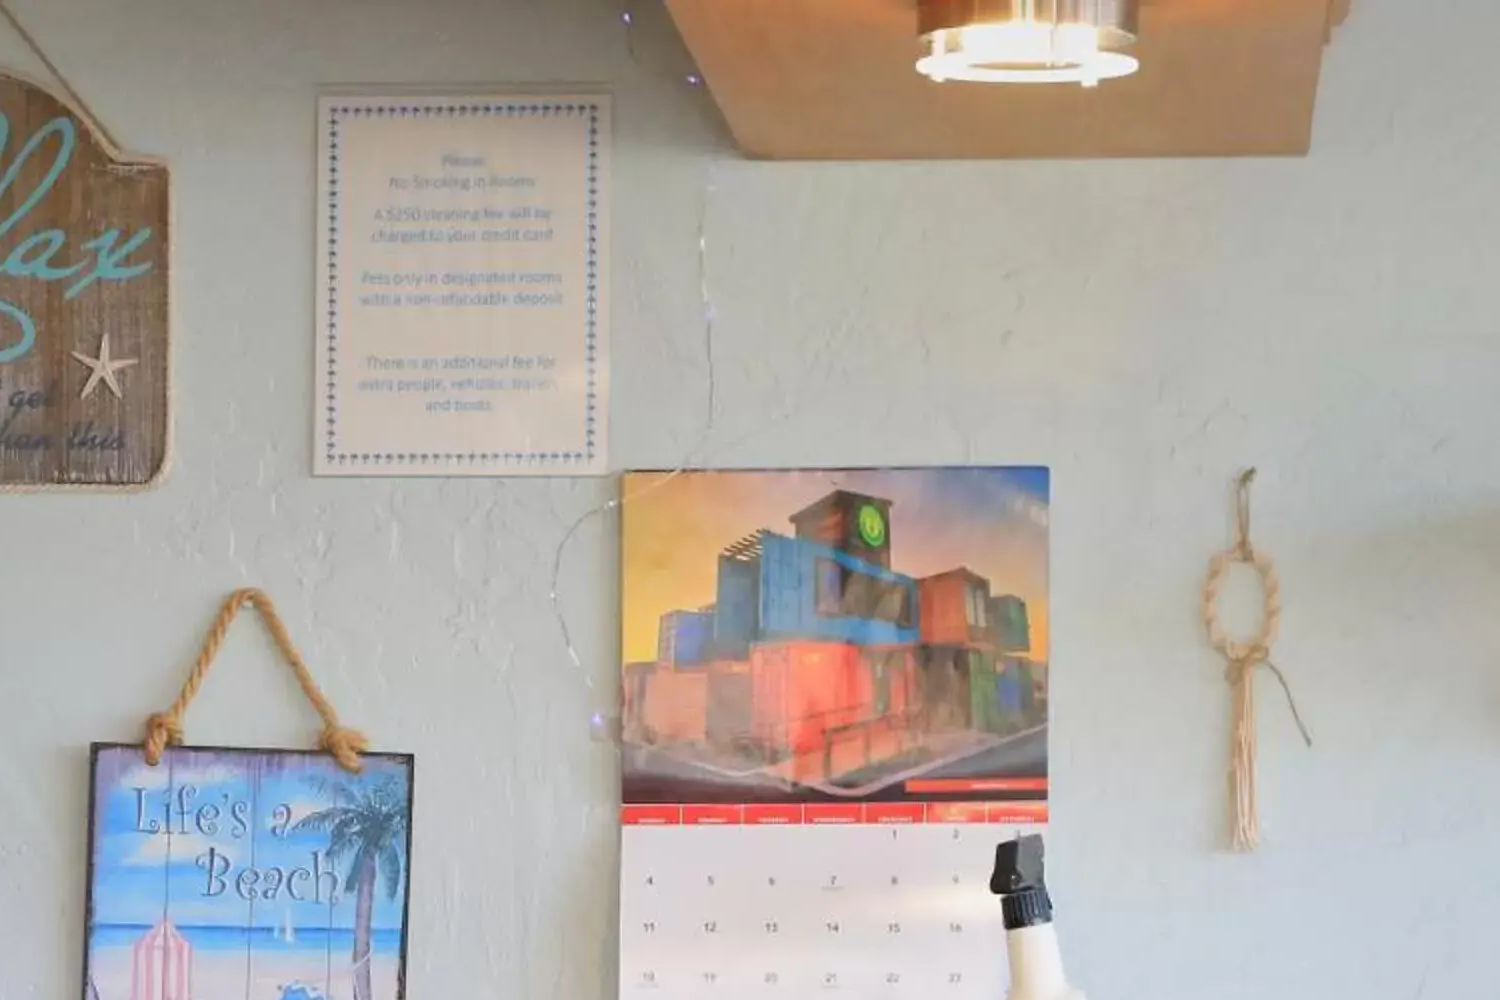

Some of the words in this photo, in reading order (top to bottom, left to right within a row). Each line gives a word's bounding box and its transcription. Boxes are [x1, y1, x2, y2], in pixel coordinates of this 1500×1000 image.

[412, 174, 470, 191] Smoking
[473, 175, 486, 189] in
[423, 207, 480, 222] cleaning
[508, 207, 532, 221] will
[370, 228, 428, 244] charged
[447, 230, 476, 244] your
[481, 228, 519, 242] credit
[361, 271, 391, 285] Pets
[392, 272, 423, 287] only
[441, 271, 516, 287] designated
[518, 272, 563, 285] rooms
[513, 292, 563, 308] deposit
[366, 356, 404, 370] There
[421, 358, 439, 370] an
[442, 356, 509, 370] additional
[512, 356, 534, 370] fee
[536, 356, 557, 370] for
[8, 379, 58, 420] get
[425, 399, 451, 413] and
[66, 418, 128, 451] this
[131, 783, 248, 839] Life's
[270, 802, 294, 839] a
[194, 846, 341, 906] Beach
[642, 921, 657, 934] 11
[703, 921, 718, 933] 12
[765, 922, 779, 934] 13
[826, 921, 840, 933] 14
[888, 922, 902, 934] 15
[949, 922, 963, 934] 16
[642, 971, 656, 983] 18
[703, 972, 718, 983] 19
[763, 972, 779, 984] 20
[824, 972, 838, 984] 21
[885, 972, 900, 984] 22
[948, 972, 963, 984] 23
